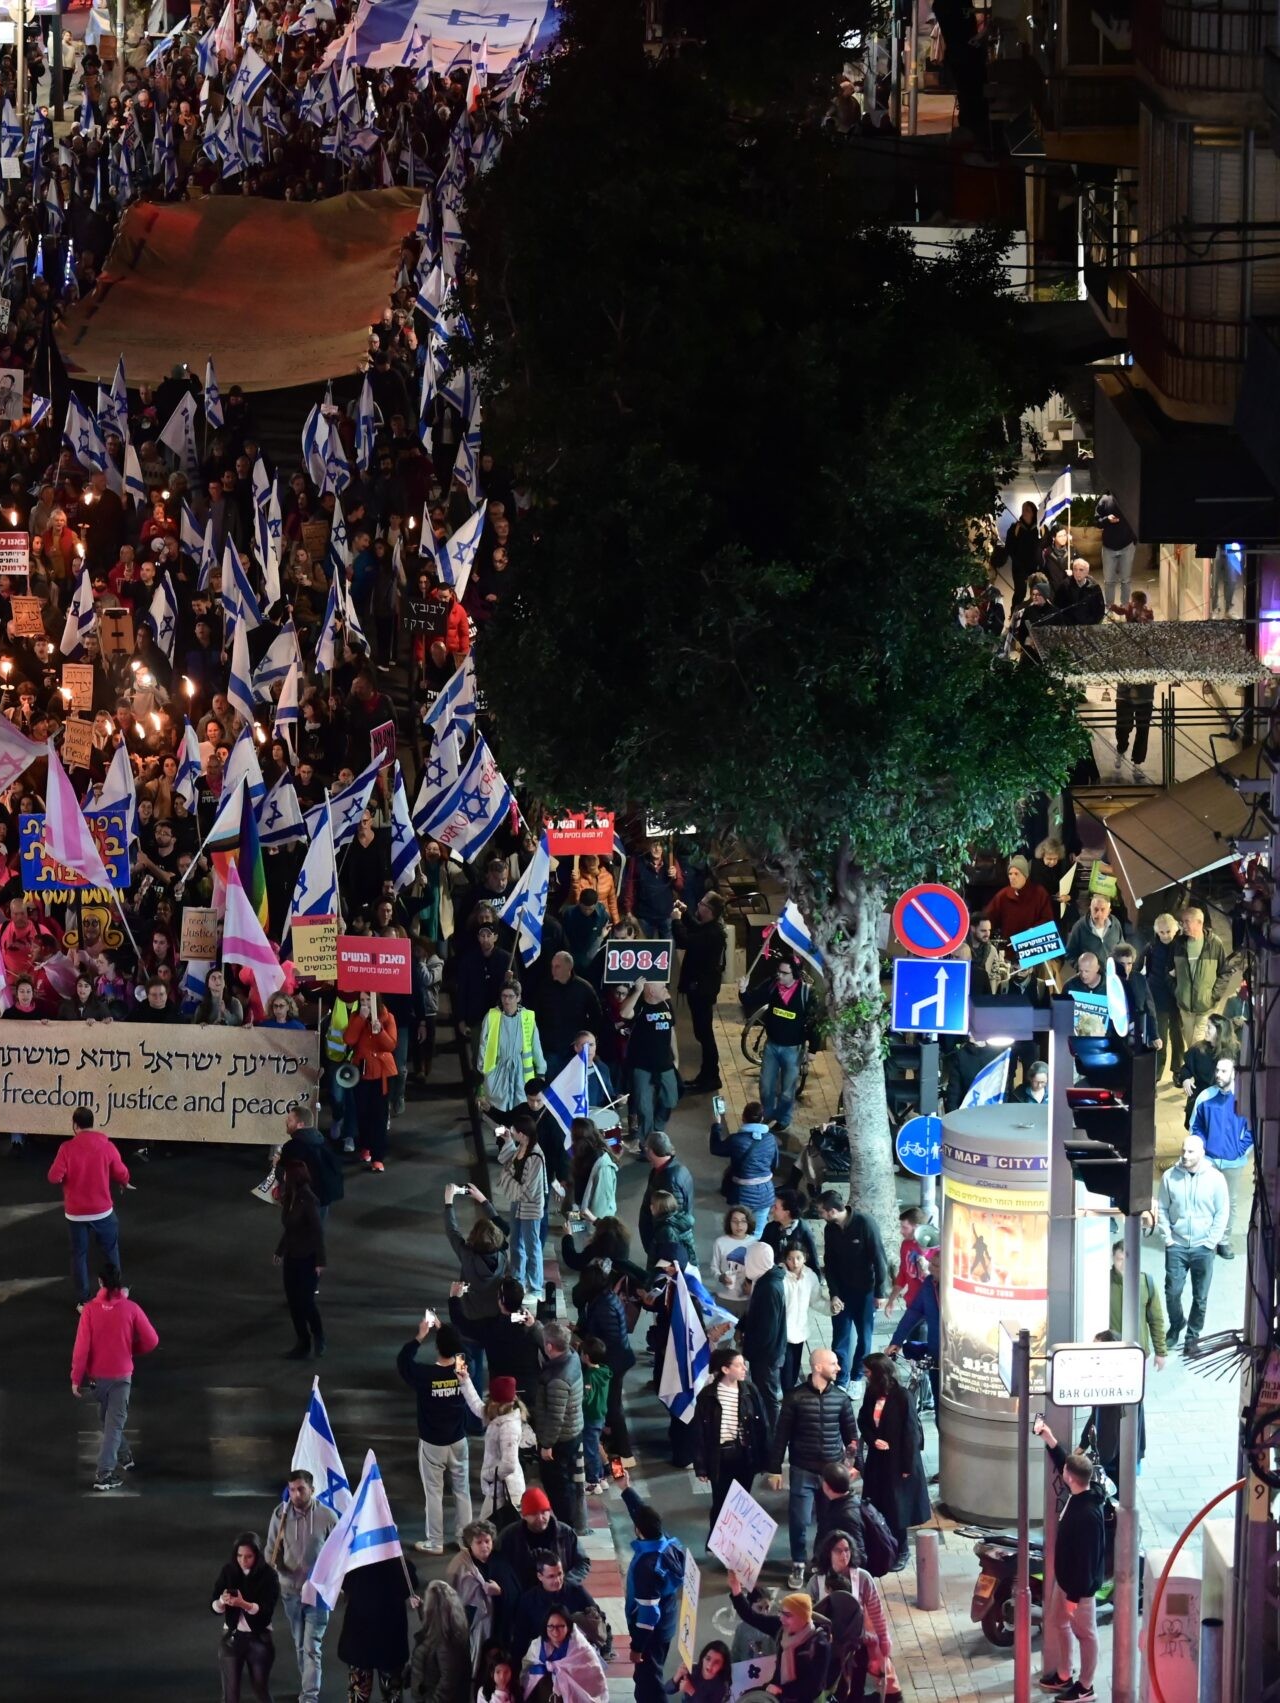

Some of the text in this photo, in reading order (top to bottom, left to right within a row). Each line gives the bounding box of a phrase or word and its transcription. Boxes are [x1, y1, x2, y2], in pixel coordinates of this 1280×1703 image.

[8, 538, 26, 546] באנו
[65, 747, 90, 762] Peace
[182, 940, 216, 953] Peace
[1018, 942, 1058, 960] אין הייטק
[341, 951, 406, 965] מאבק הנשים
[608, 950, 668, 971] 1984
[76, 1047, 131, 1072] תהא
[138, 1040, 222, 1074] ישראל
[1, 1072, 100, 1113] freedom,
[99, 1083, 178, 1127] justice
[183, 1081, 226, 1113] and
[954, 1150, 980, 1164] MAP
[998, 1158, 1034, 1169] CITY
[1059, 1388, 1080, 1399] BAR
[1083, 1387, 1123, 1398] GIYORA
